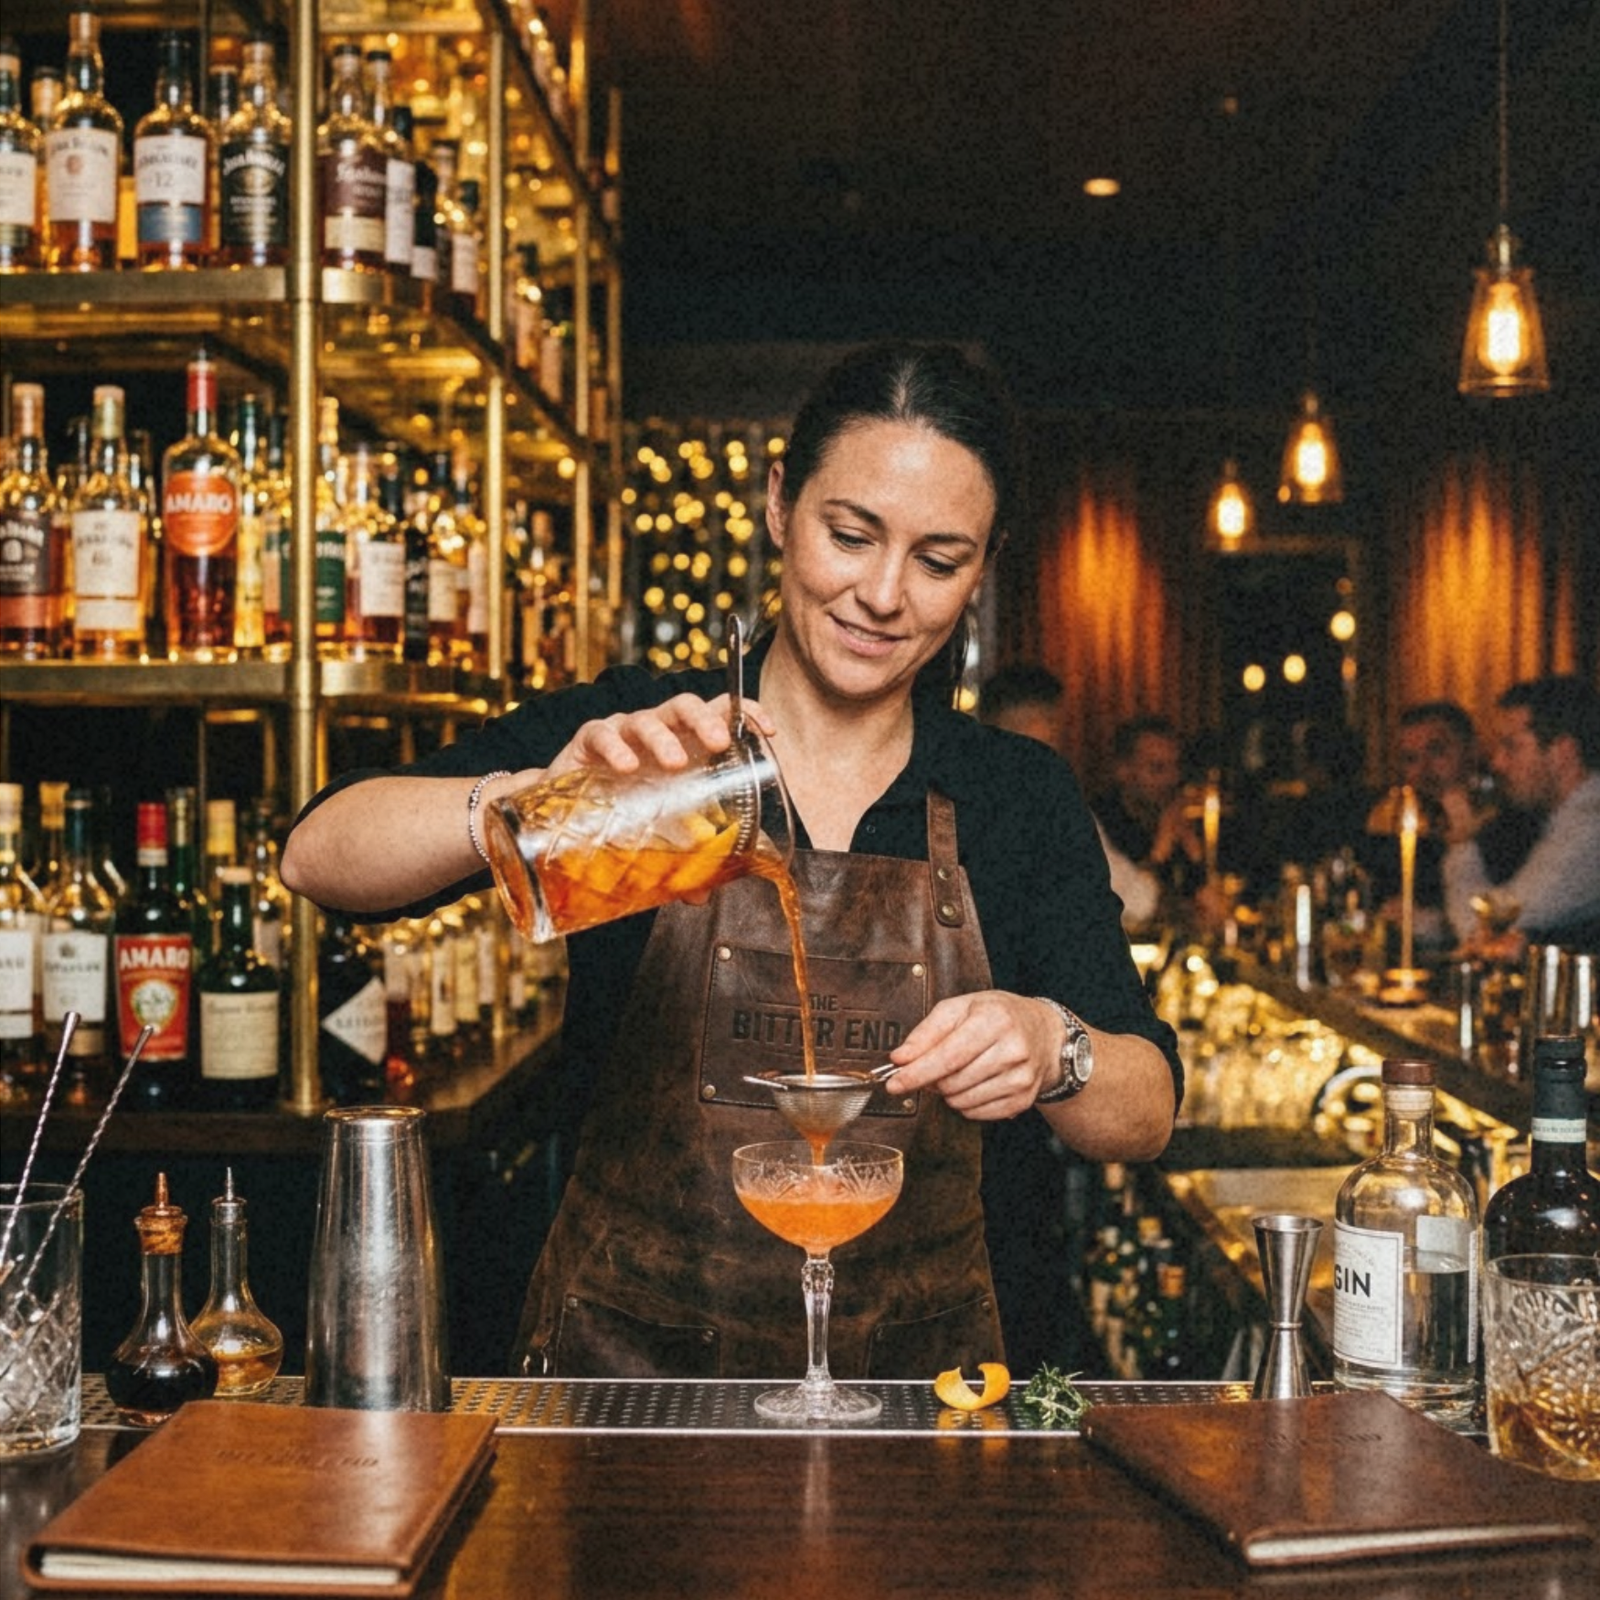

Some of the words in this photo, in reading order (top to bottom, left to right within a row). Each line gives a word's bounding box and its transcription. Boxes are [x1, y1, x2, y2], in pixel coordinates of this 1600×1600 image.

[155, 172, 173, 188] 12
[166, 492, 233, 515] AMARO
[120, 946, 190, 971] AMARO
[808, 993, 838, 1011] THE
[845, 1018, 902, 1051] END
[1334, 1264, 1371, 1297] GIN
